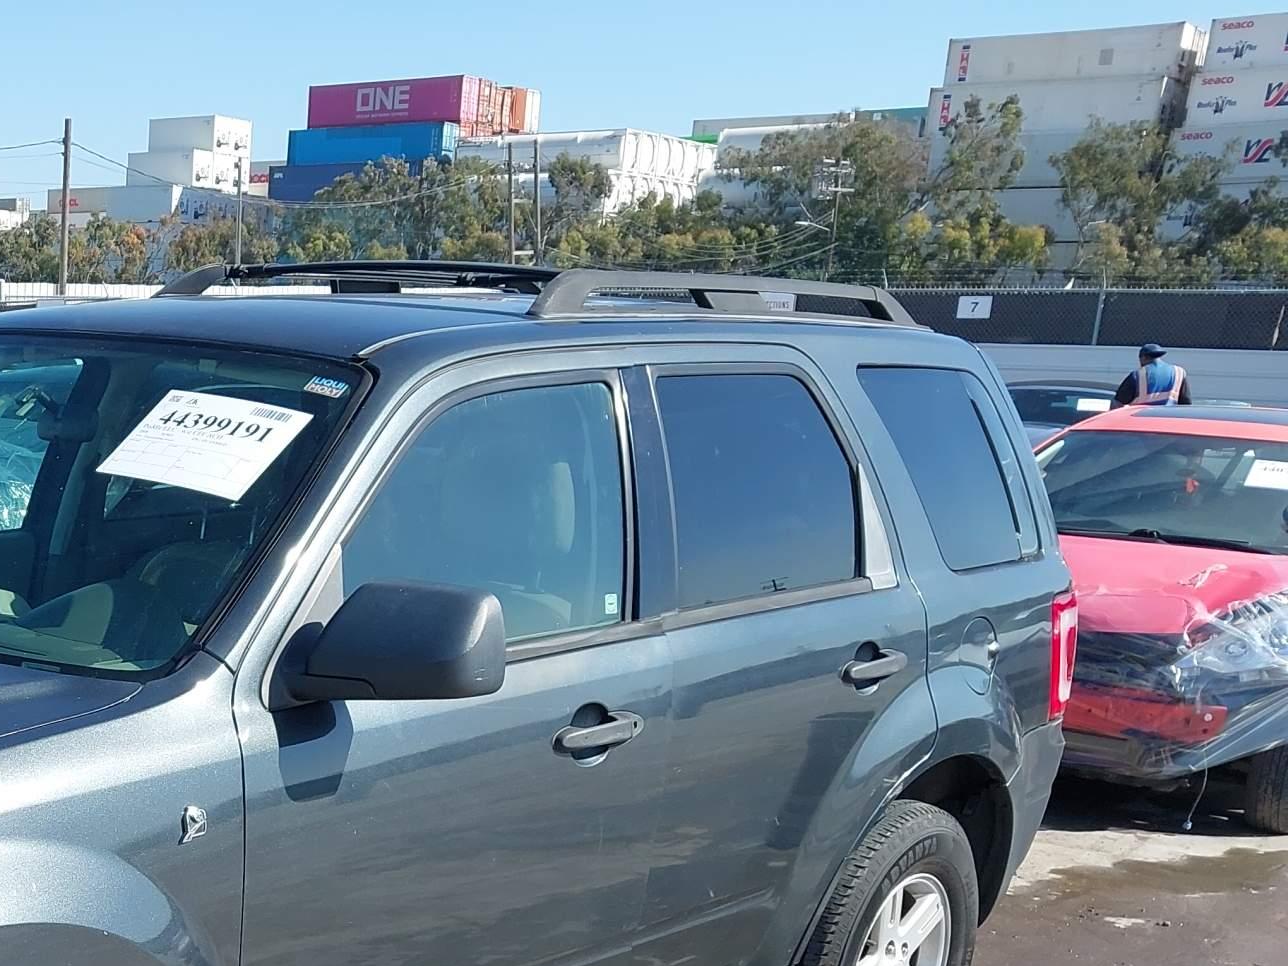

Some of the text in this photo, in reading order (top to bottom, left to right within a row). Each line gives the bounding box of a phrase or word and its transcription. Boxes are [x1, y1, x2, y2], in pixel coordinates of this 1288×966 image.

[1221, 20, 1254, 30] seaco
[1201, 76, 1234, 86] seaco
[356, 85, 410, 111] ONE
[1180, 131, 1213, 141] seaco
[58, 198, 79, 207] OCL
[970, 301, 980, 313] 7
[314, 376, 346, 390] LIQUI
[308, 383, 341, 397] MOLY
[159, 410, 274, 442] 44399191
